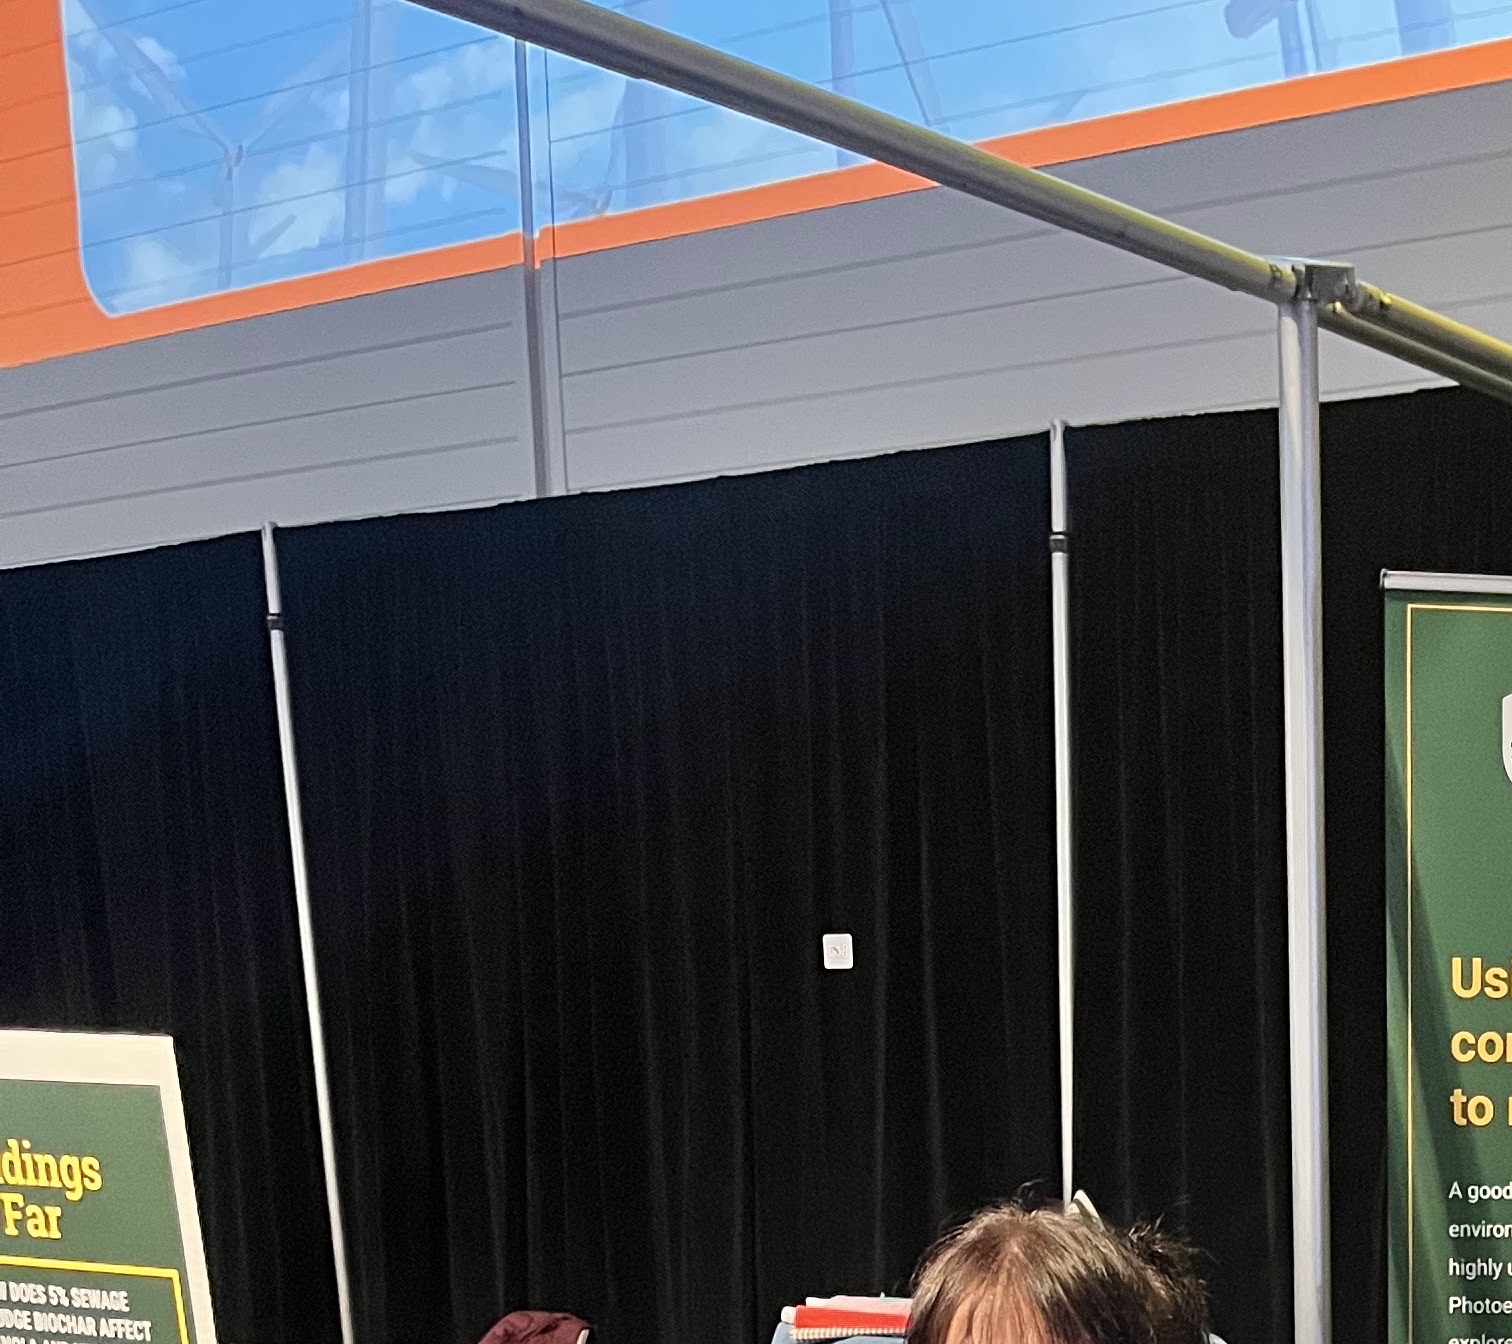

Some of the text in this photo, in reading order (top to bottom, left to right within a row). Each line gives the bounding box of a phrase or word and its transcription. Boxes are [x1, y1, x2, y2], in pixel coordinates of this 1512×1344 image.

[1449, 1088, 1494, 1126] to
[0, 1138, 103, 1201] dings
[1448, 1181, 1462, 1199] A
[1467, 1181, 1512, 1203] good
[0, 1193, 61, 1239] Far
[1448, 1257, 1503, 1280] highly
[9, 1281, 46, 1304] DOES
[48, 1285, 69, 1307] 5%
[70, 1287, 130, 1312] SEWAGE
[33, 1311, 97, 1336] BIOCHAR
[100, 1320, 152, 1341] AFFECT
